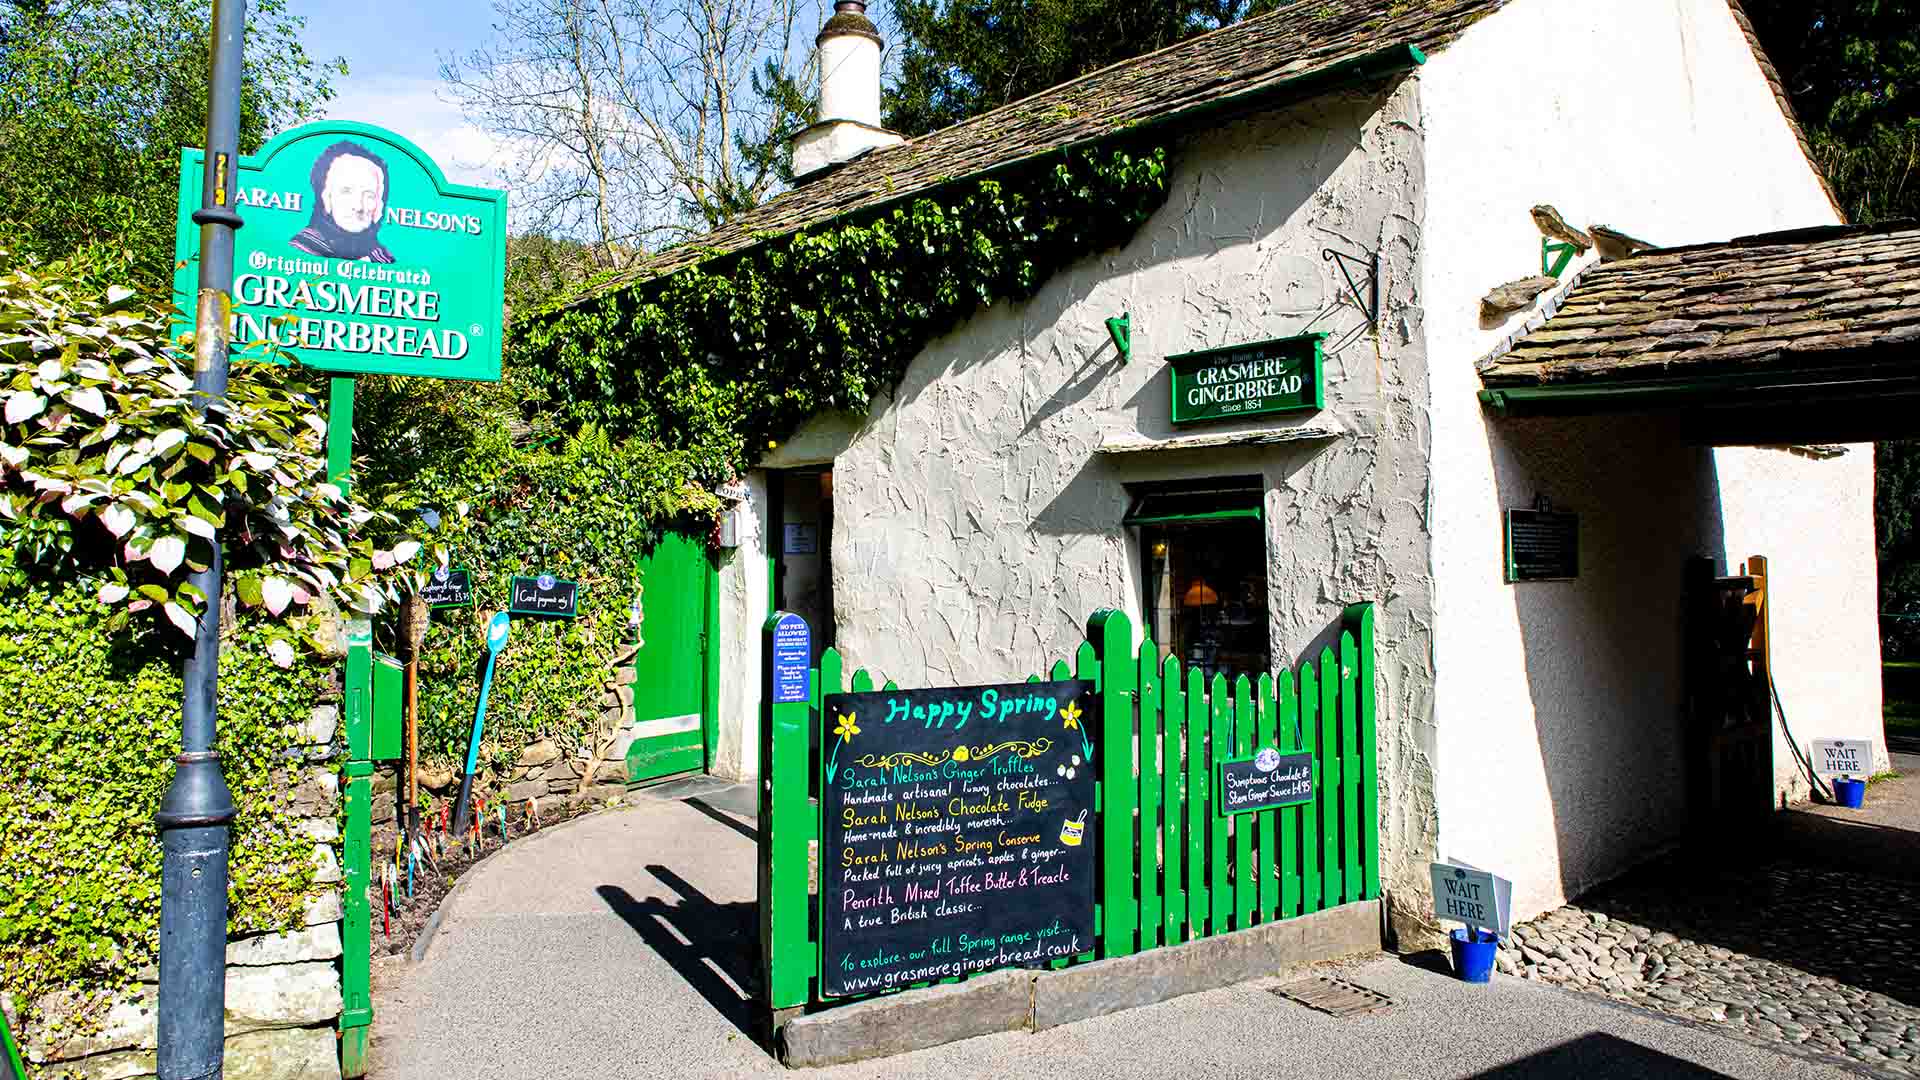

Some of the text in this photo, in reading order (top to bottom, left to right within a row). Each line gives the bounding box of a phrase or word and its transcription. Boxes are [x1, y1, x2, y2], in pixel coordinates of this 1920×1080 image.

[234, 188, 482, 236] ARAH NELSON'S
[248, 250, 432, 285] Original Celebrated
[233, 273, 441, 322] GRASMERE
[229, 312, 470, 361] INGERBREAD
[1196, 356, 1288, 386] GRASMERE
[1187, 375, 1303, 406] GINGERBREAD
[1221, 398, 1262, 413] since 1854
[519, 589, 537, 602] Card
[884, 689, 1057, 730] Happy Spring
[1824, 748, 1857, 760] WAIT
[1826, 759, 1861, 771] HERE
[842, 755, 1034, 790] Sarah Nelson's Ginger Truffles
[1226, 772, 1268, 789] Sumptuous
[1271, 766, 1302, 782] Chocolate
[843, 773, 1059, 805] Handmade artisanal luxury chocolates...
[1228, 790, 1247, 804] Stem
[1248, 788, 1270, 802] Ginger
[1270, 784, 1291, 797] Sauce
[842, 790, 1048, 828] Sarah Nelson's Chocolate Fudge
[843, 813, 1014, 845] Home-made & incredibly moreish...
[842, 843, 889, 868] Sarah
[896, 839, 948, 861] Nelson's
[954, 834, 993, 854] Spring
[998, 830, 1041, 847] Conserve
[844, 865, 881, 882] Packed
[885, 864, 902, 877] full
[905, 862, 916, 875] of
[918, 862, 942, 876] juicy
[988, 850, 1015, 865] apples
[1021, 847, 1029, 860] &
[1031, 847, 1067, 863] ginger...
[843, 863, 1070, 913] Penrith Mixed Toffee Butter & Treacle
[1443, 877, 1481, 900] WAIT
[844, 898, 983, 931] A true British classic...
[1446, 898, 1486, 921] HERE
[840, 952, 856, 972] To
[909, 949, 927, 960] our
[931, 936, 952, 955] full
[959, 934, 996, 953] Spring
[1000, 931, 1032, 944] range
